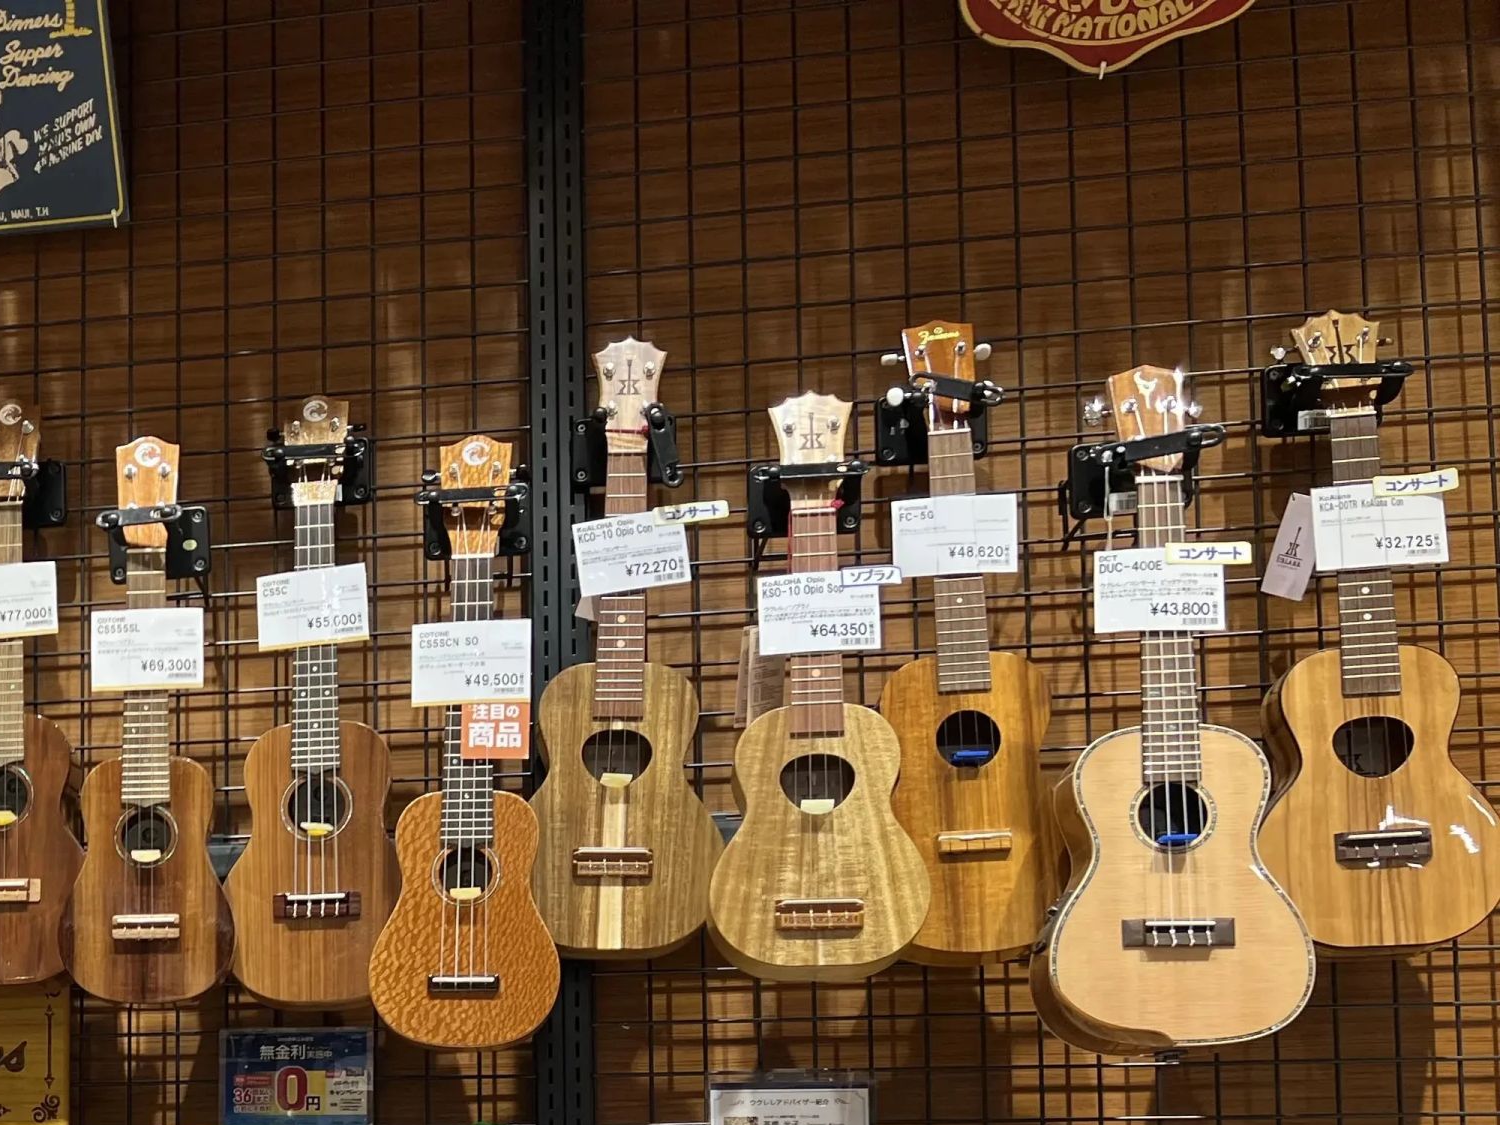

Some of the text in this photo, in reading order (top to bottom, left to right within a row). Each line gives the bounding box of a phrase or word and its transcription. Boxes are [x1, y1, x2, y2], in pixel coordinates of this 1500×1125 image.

[0, 39, 64, 67] Supper
[0, 65, 74, 92] Dancing
[52, 98, 94, 132] SUPPORT
[74, 113, 96, 135] OWN
[919, 328, 960, 346] Famous
[1384, 475, 1449, 493] コンサート
[665, 504, 721, 520] コンサート
[898, 510, 935, 522] FC-5G
[578, 524, 653, 544] KCO-10 Opio Con
[1374, 535, 1434, 550] ¥32,725
[948, 544, 1005, 560] ¥48,620
[1178, 546, 1243, 560] コンサート
[625, 558, 678, 577] ¥72,270
[1099, 562, 1163, 574] DUC-400E
[850, 569, 894, 583] ソプラノ
[762, 584, 844, 598] KSO-10 Opio Sop
[0, 607, 47, 622] ¥77,000
[1149, 602, 1211, 617] ¥43,800
[307, 614, 357, 628] ¥55,000
[809, 622, 868, 637] ¥64,350
[141, 658, 191, 672] ¥69,300
[464, 673, 518, 687] ¥49,500
[472, 704, 519, 720] 注目の
[468, 722, 522, 748] 商品
[260, 1044, 306, 1061] 無金利
